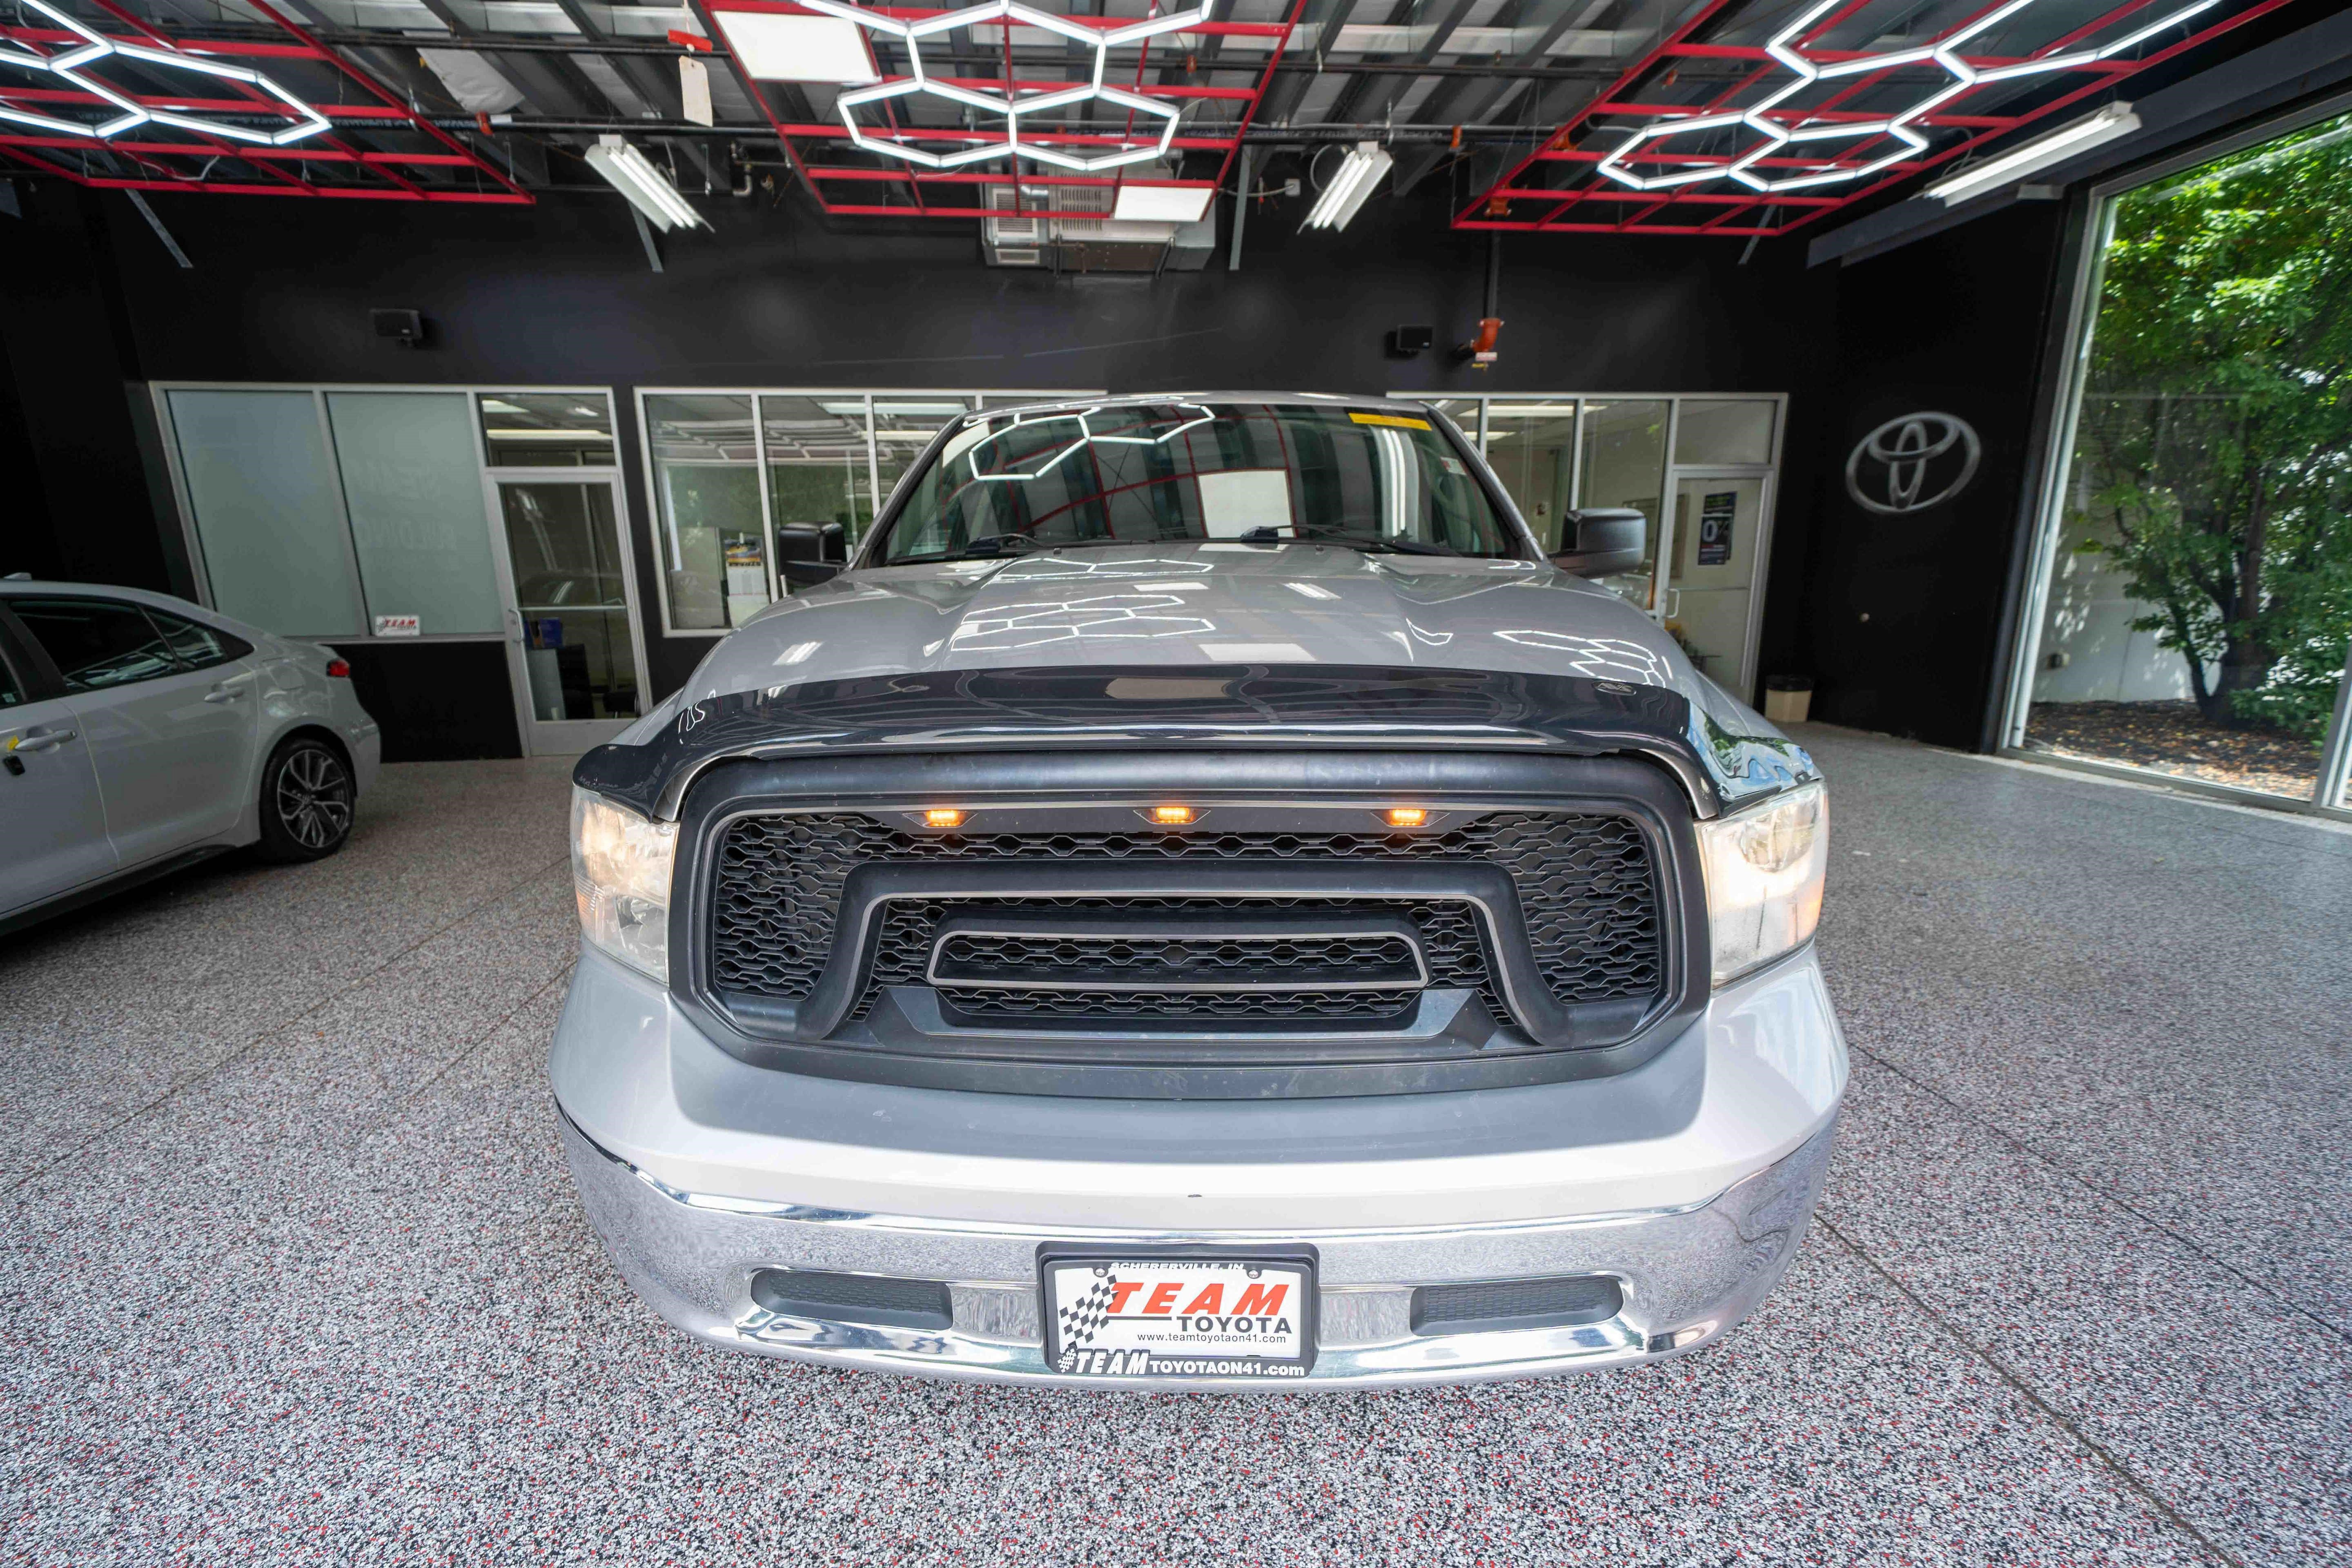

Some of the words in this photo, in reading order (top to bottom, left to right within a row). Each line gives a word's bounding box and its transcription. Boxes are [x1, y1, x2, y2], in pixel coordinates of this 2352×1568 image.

[1107, 1282, 1289, 1315] TEAM
[1176, 1316, 1292, 1334] TOYOTA
[1137, 1332, 1286, 1344] www.teamtoyotaon41.com
[1075, 1351, 1150, 1375] TEAM
[1149, 1361, 1305, 1376] TOYOTAON41.com
